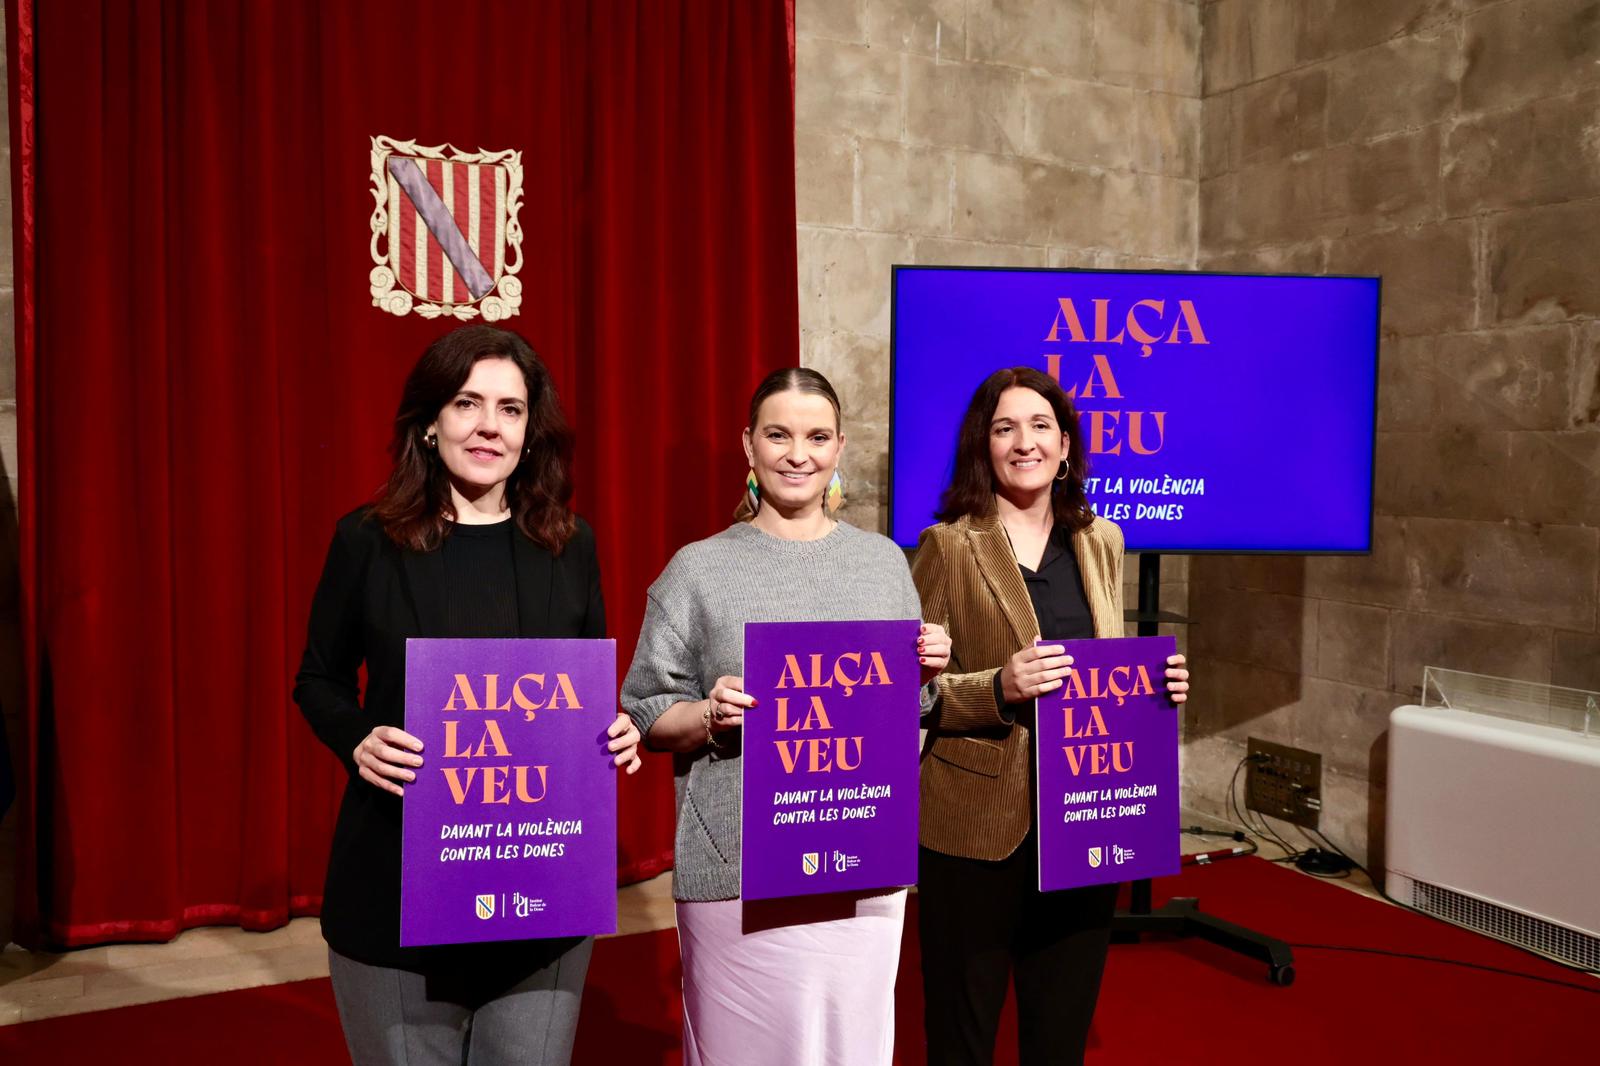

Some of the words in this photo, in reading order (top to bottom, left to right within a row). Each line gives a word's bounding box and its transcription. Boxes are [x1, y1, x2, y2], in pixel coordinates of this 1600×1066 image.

[1043, 297, 1210, 358] ALÇA
[1043, 354, 1124, 399] LA
[1076, 410, 1167, 456] EU
[1104, 478, 1123, 495] LA
[1129, 474, 1205, 496] VIOLÈNCIA
[1104, 503, 1131, 520] LES
[1136, 503, 1184, 520] DONES
[774, 651, 893, 697] ALÇA
[1061, 665, 1155, 706] ALÇA
[441, 673, 583, 721] ALÇA
[774, 695, 833, 732] LA
[441, 719, 512, 758] LA
[1062, 705, 1110, 739] LA
[773, 736, 864, 774] VEU
[1062, 741, 1135, 776] VEU
[440, 765, 549, 805] VEU
[773, 790, 818, 806] DAVANT
[819, 789, 833, 802] LA
[838, 783, 891, 801] VIOLÈNCIA
[1063, 790, 1098, 805] DAVANT
[1100, 788, 1112, 801] LA
[1114, 783, 1157, 800] VIOLÈNCIA
[440, 823, 493, 840] DAVANT
[496, 823, 512, 838] LA
[518, 817, 582, 838] VIOLÈNCIA
[773, 809, 815, 826] CONTRA
[819, 807, 838, 821] LES
[842, 805, 877, 820] DONES
[1063, 807, 1098, 824] CONTRA
[1100, 806, 1117, 819] LES
[1119, 803, 1147, 817] DONES
[440, 845, 491, 862] CONTRA
[496, 844, 519, 859] LES
[524, 842, 565, 858] DONES
